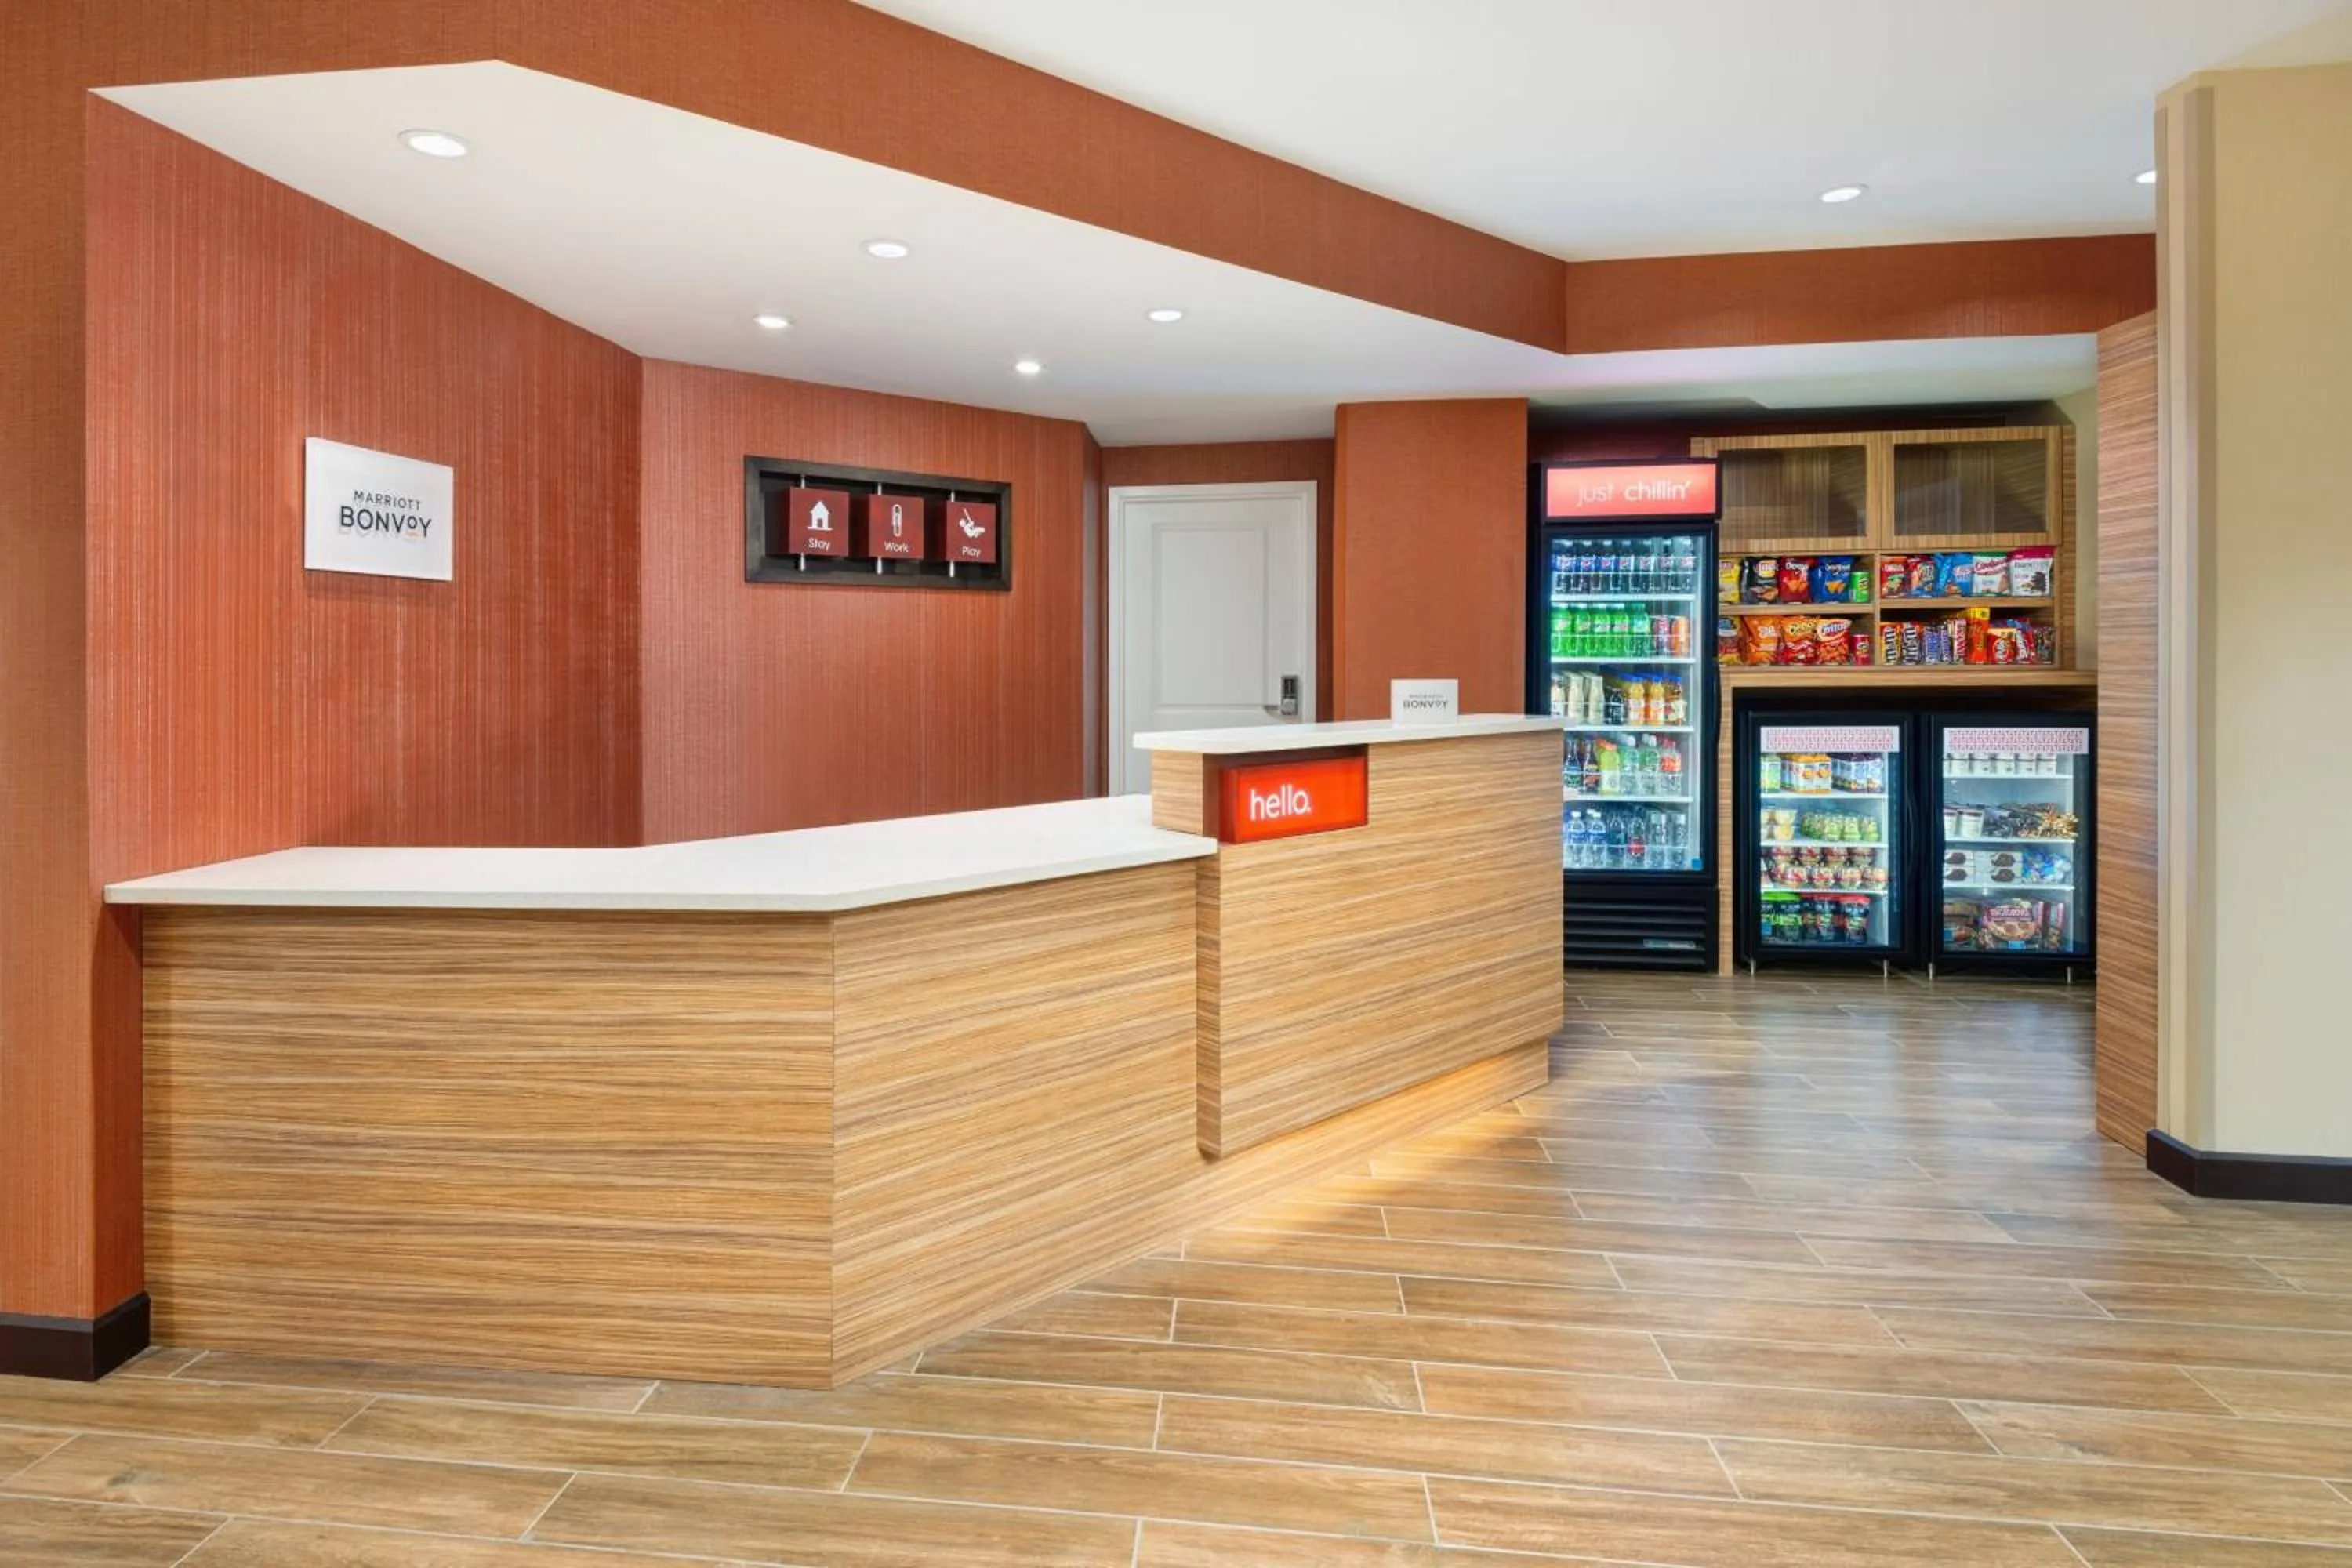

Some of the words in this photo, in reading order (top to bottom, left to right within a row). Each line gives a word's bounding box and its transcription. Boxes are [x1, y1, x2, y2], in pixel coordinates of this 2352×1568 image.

[354, 489, 422, 510] MARRIOTT
[1577, 483, 1614, 508] just
[1623, 480, 1692, 502] chillin'
[340, 505, 432, 538] BONVOY
[808, 538, 831, 550] Stay
[884, 541, 909, 554] Work
[962, 546, 982, 557] Play
[1250, 784, 1312, 821] hello.
